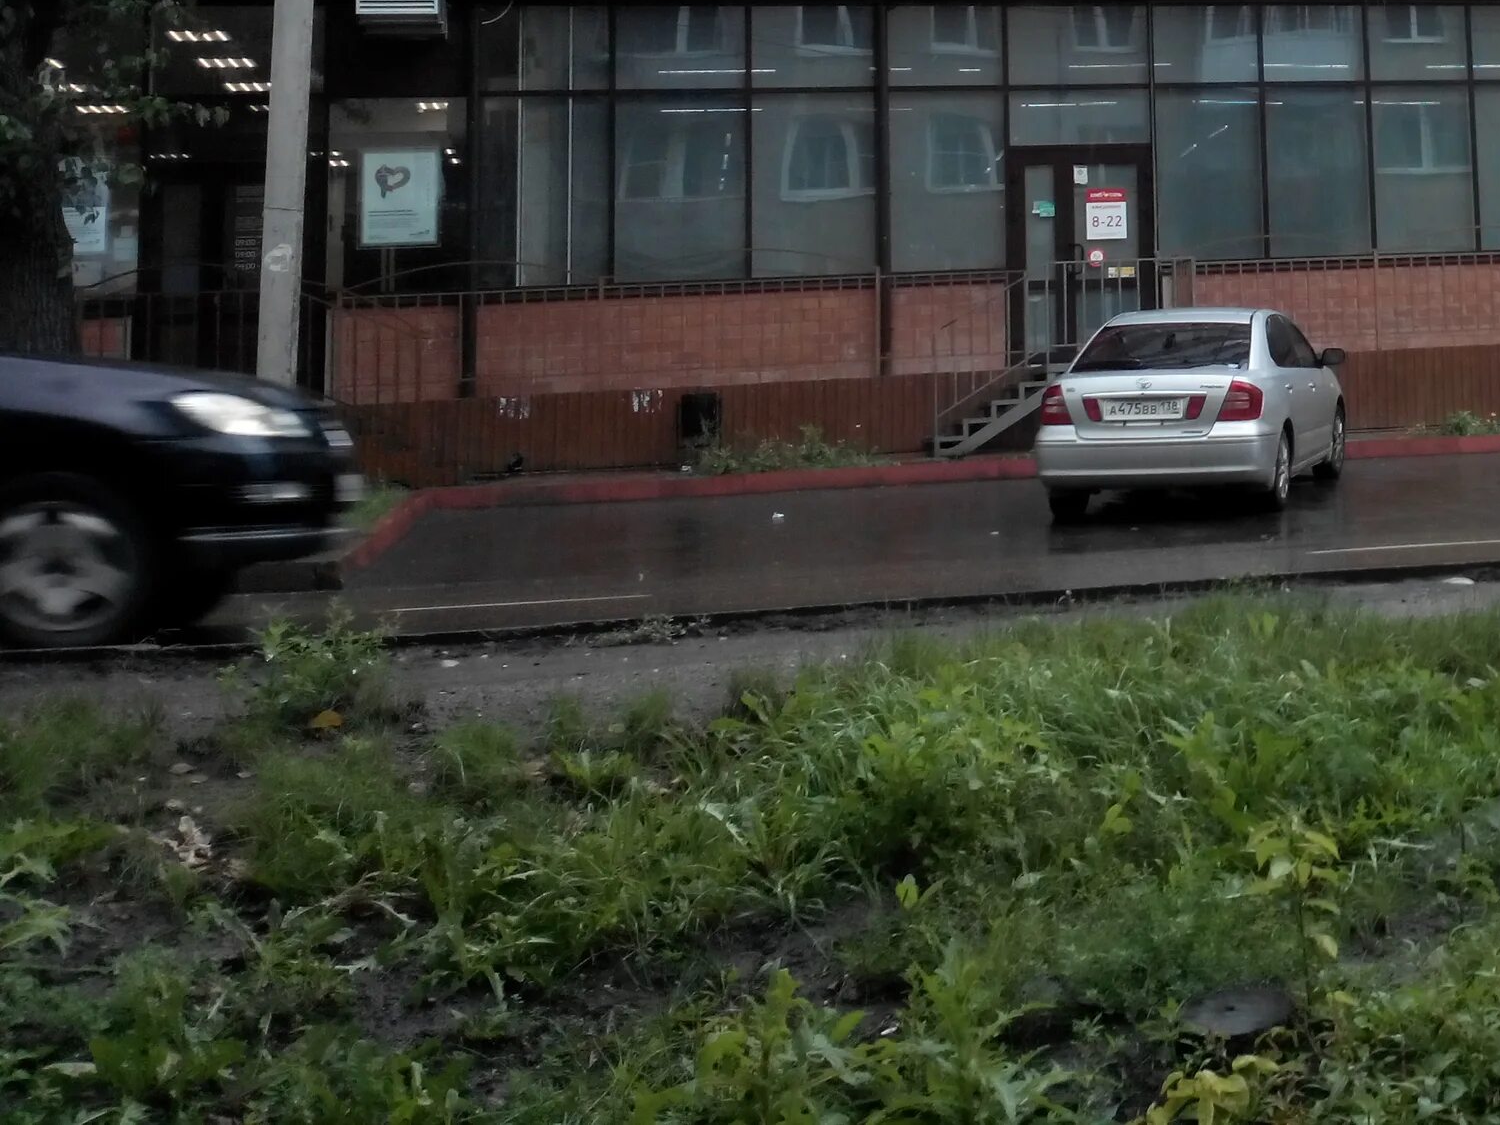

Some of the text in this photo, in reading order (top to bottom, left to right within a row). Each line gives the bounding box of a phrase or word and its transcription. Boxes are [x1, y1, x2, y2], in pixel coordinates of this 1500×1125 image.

[1092, 215, 1122, 227] 8-22
[1110, 401, 1179, 416] А475ВВ 138
